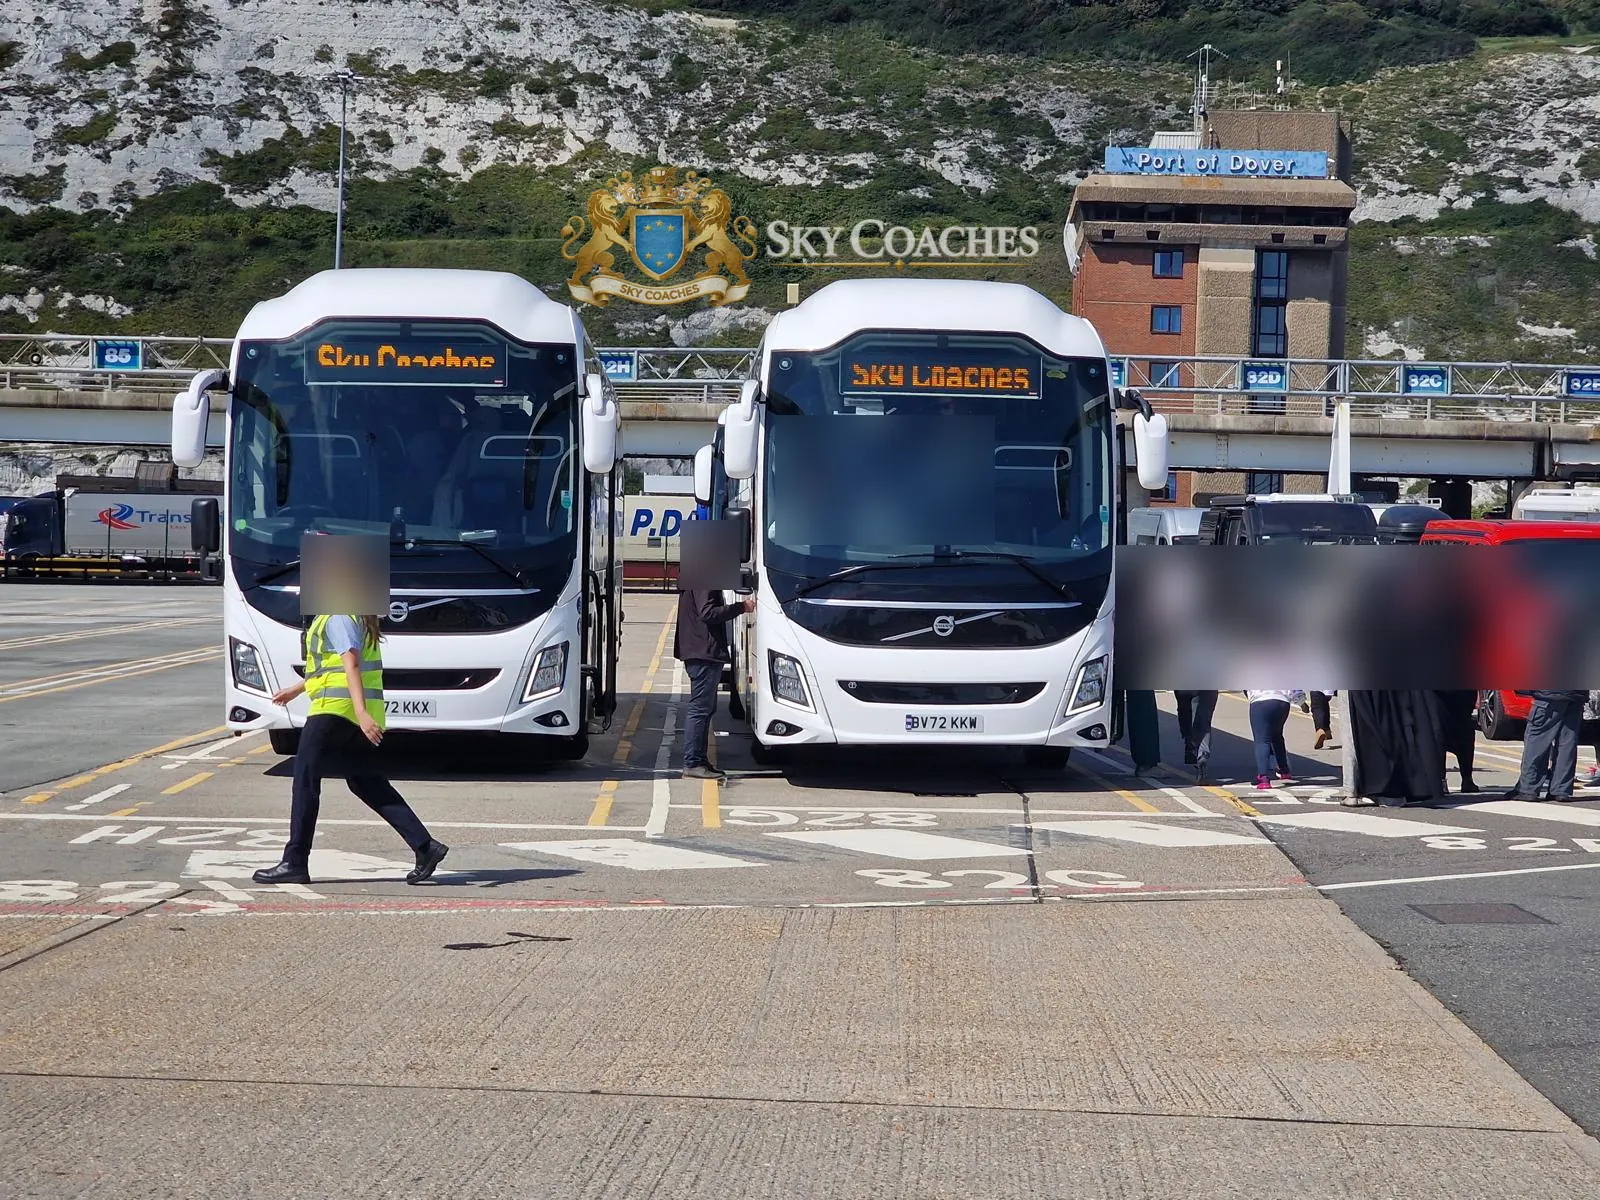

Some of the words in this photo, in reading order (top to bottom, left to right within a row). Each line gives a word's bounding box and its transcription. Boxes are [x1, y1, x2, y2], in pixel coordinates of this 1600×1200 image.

[1137, 153, 1184, 170] Port
[1196, 154, 1219, 171] of
[1230, 155, 1296, 173] Dover
[104, 347, 132, 363] 85
[1246, 370, 1281, 384] 82D
[1408, 374, 1443, 387] 82C
[135, 510, 191, 523] Trans
[630, 508, 696, 537] P.D
[384, 701, 399, 714] 72
[402, 701, 430, 714] KKX
[912, 716, 947, 729] BV72
[951, 716, 978, 729] KKW
[854, 869, 1145, 889] 82G
